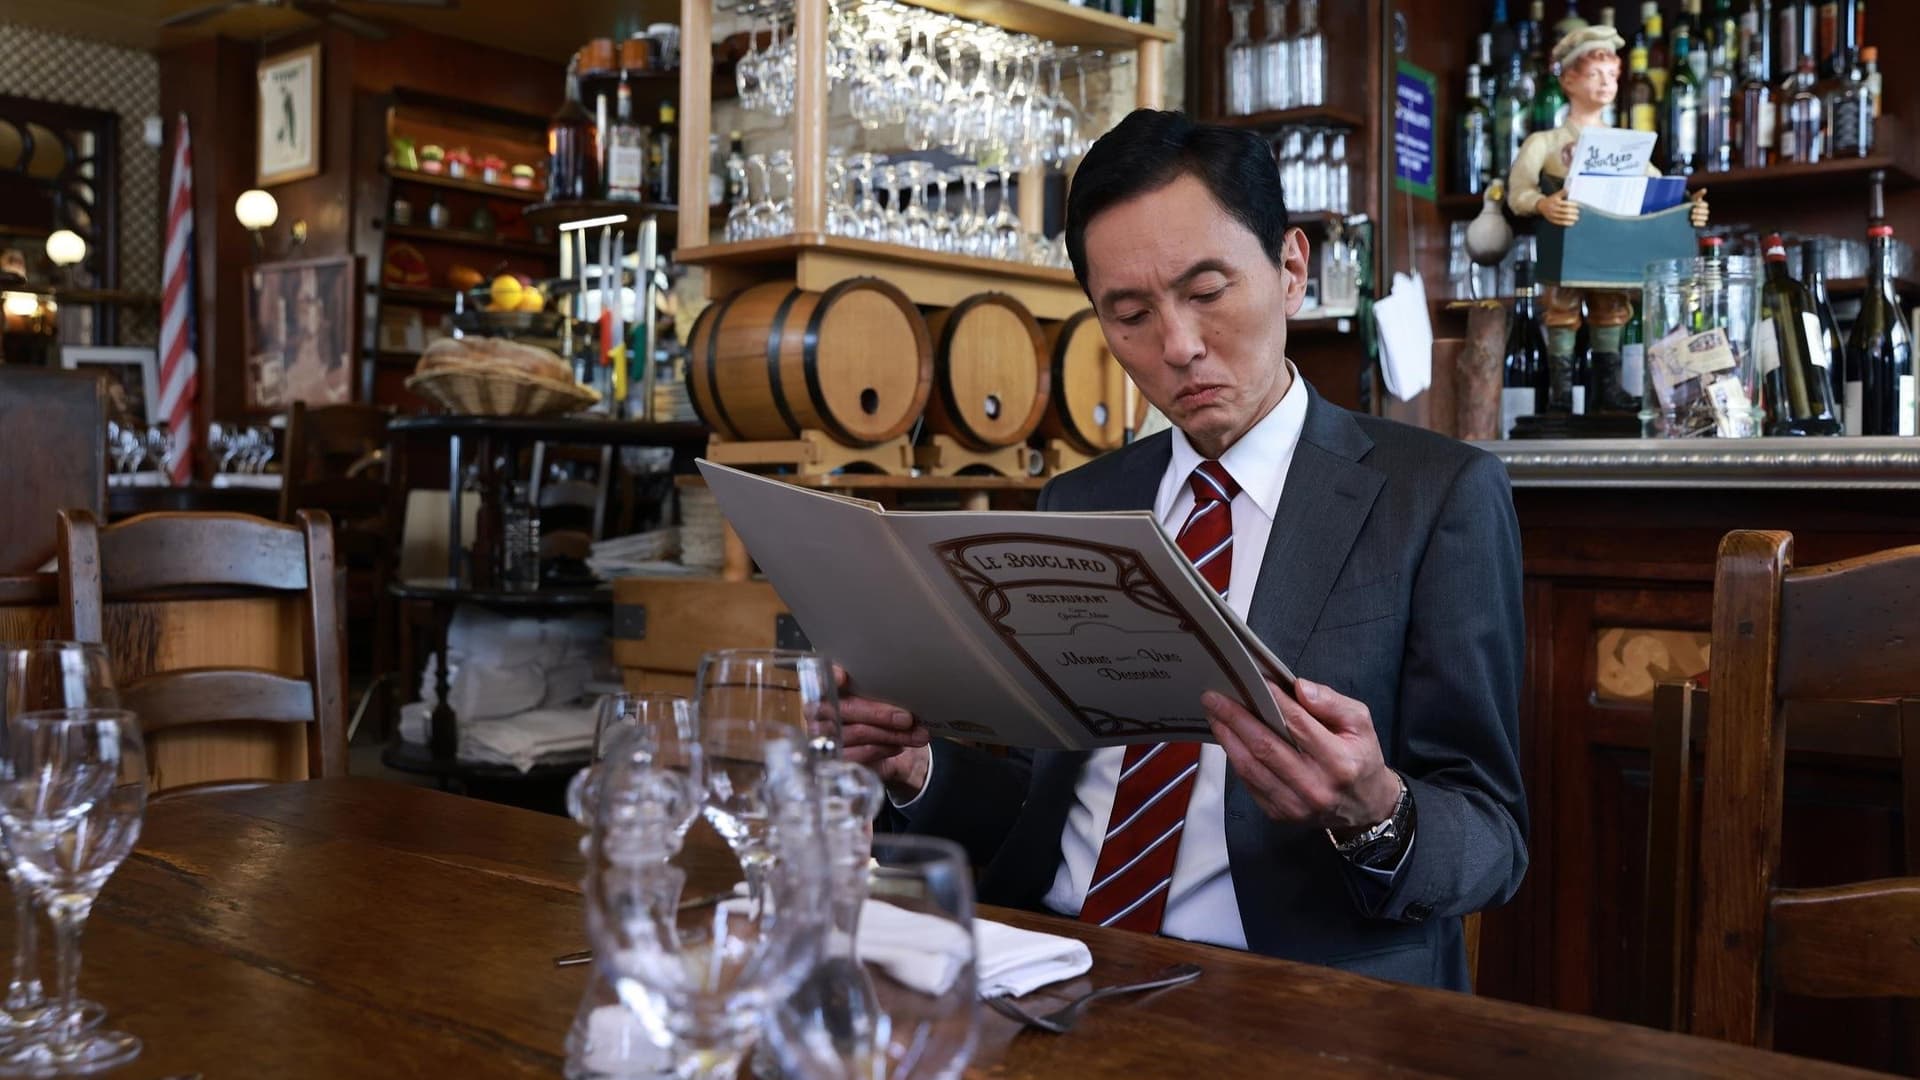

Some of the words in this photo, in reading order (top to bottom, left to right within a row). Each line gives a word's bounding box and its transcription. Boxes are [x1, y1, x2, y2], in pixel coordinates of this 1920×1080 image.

[973, 555, 1002, 570] LE
[1003, 552, 1107, 573] BOUCLARD
[1026, 592, 1108, 604] RESTAURANT
[1056, 651, 1113, 666] Menus
[1137, 648, 1182, 663] Vins
[1096, 666, 1172, 681] Desserts
